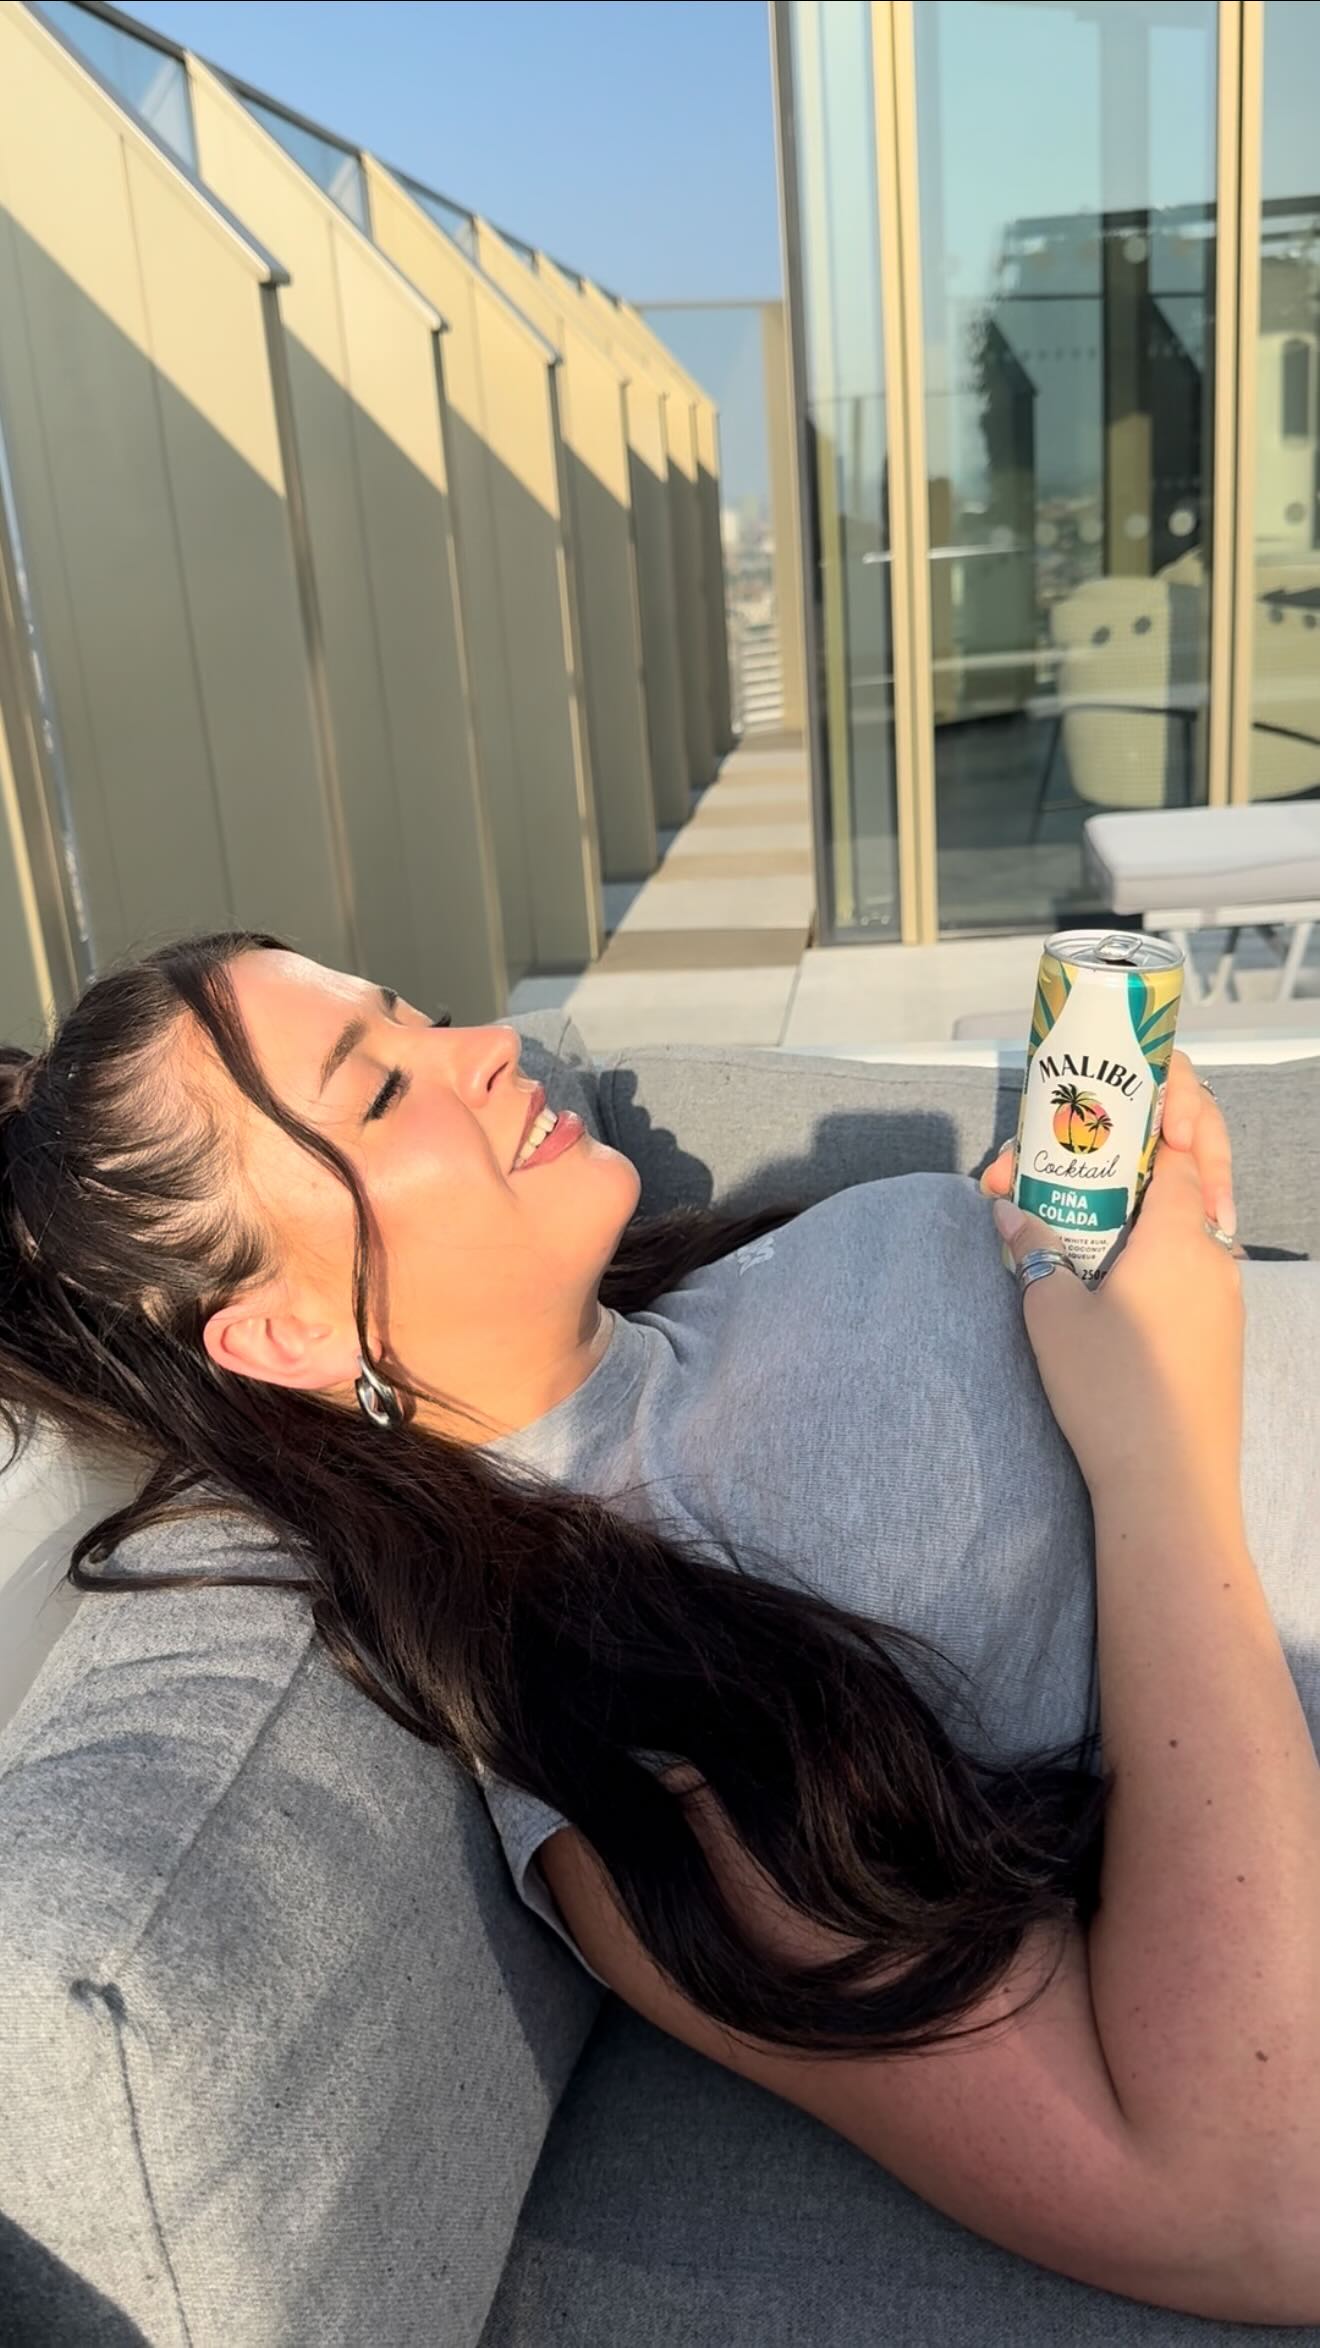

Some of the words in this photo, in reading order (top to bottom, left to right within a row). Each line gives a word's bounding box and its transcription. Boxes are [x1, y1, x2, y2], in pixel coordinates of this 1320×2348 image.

[1033, 1150, 1120, 1178] Cocktail
[1051, 1190, 1088, 1209] PIÑA
[1038, 1203, 1098, 1226] COLADA
[1064, 1237, 1089, 1245] WHITE
[1067, 1244, 1107, 1252] COCONUT
